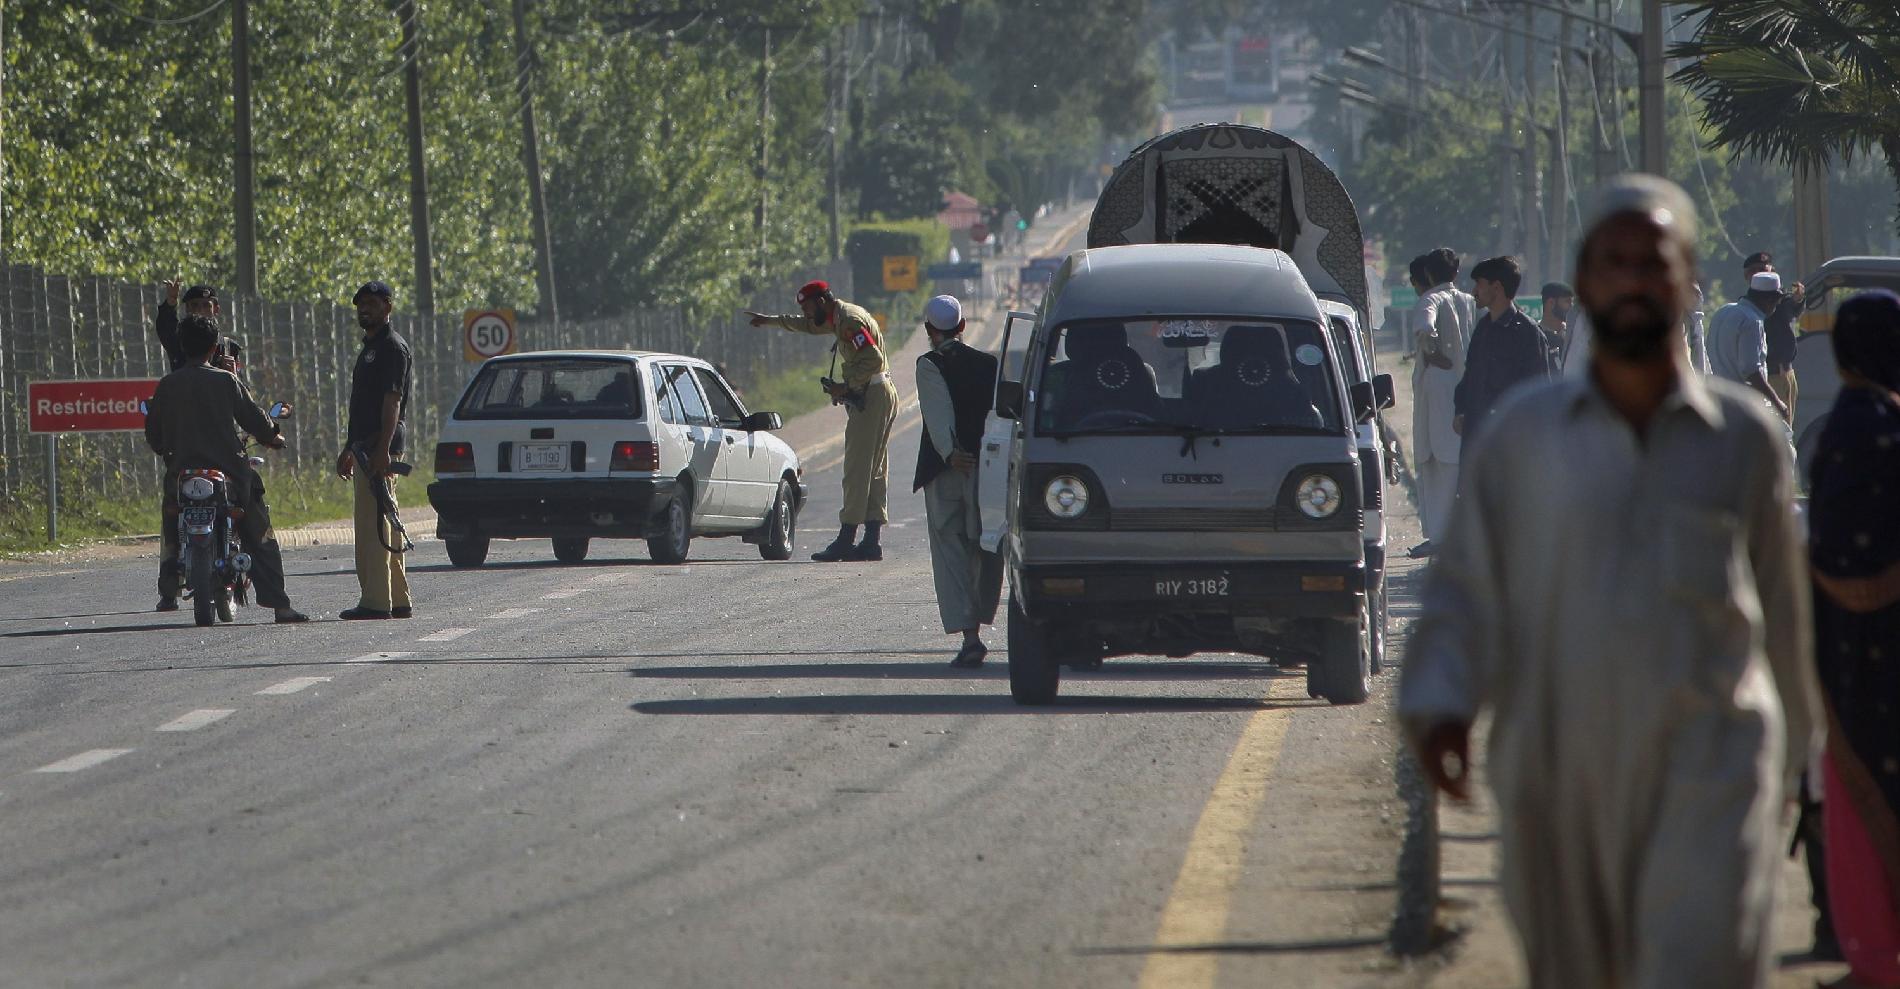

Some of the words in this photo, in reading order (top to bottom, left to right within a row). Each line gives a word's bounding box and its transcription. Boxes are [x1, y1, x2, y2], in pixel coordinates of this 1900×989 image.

[477, 325, 504, 348] 50
[37, 397, 139, 416] Restricted
[1156, 581, 1182, 596] RIY
[1187, 579, 1229, 596] 3182
